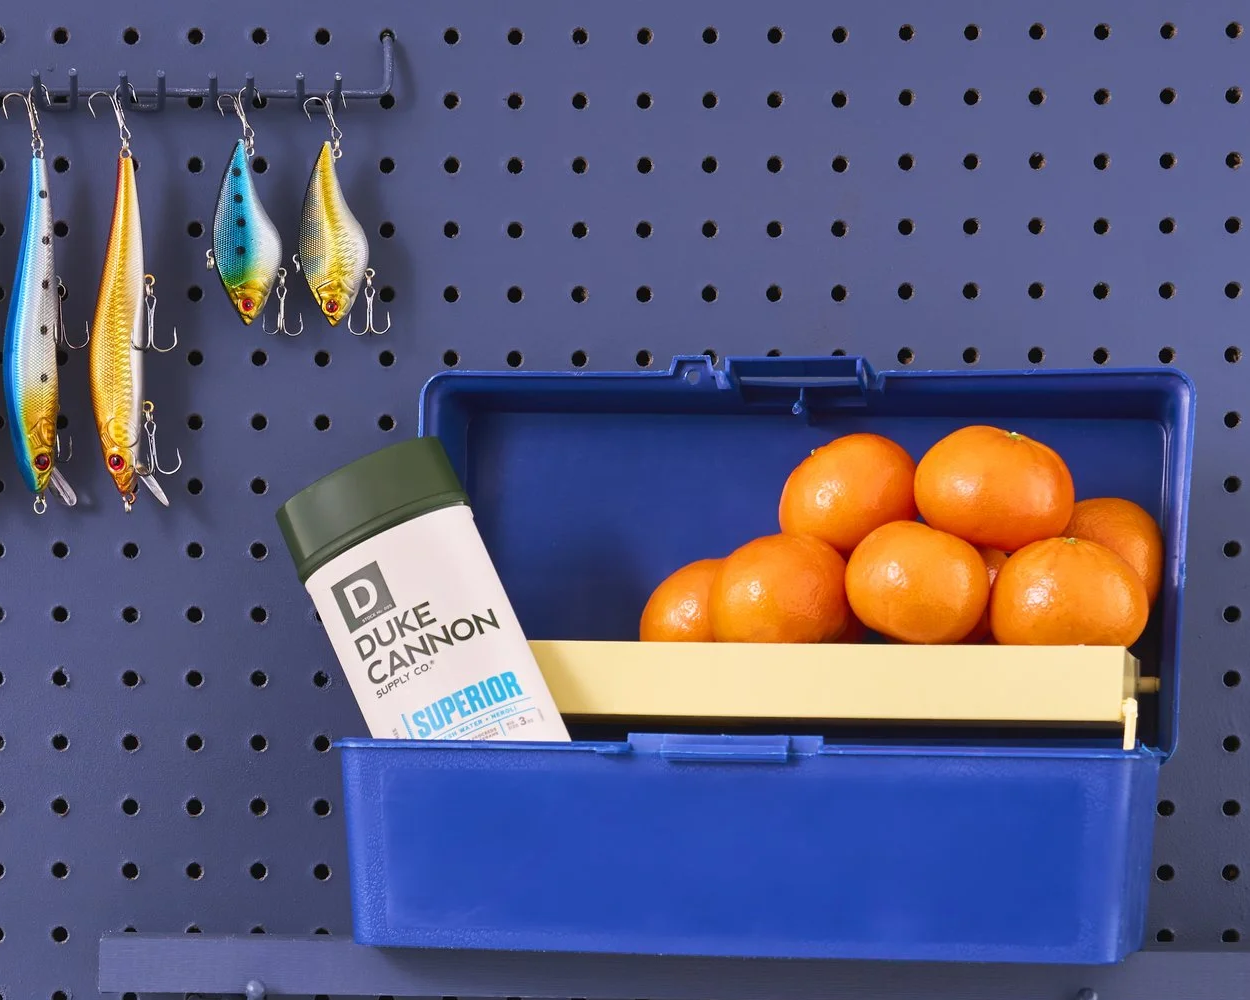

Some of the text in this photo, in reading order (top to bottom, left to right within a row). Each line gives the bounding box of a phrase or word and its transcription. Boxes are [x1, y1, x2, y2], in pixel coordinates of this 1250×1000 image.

[343, 578, 378, 619] D
[354, 601, 437, 662] DUKE
[367, 608, 500, 684] CANNON
[376, 672, 410, 699] SUPPLY
[412, 671, 523, 738] SUPERIOR
[459, 719, 483, 733] WATER
[490, 706, 517, 719] NEROLI
[519, 716, 527, 726] 3
